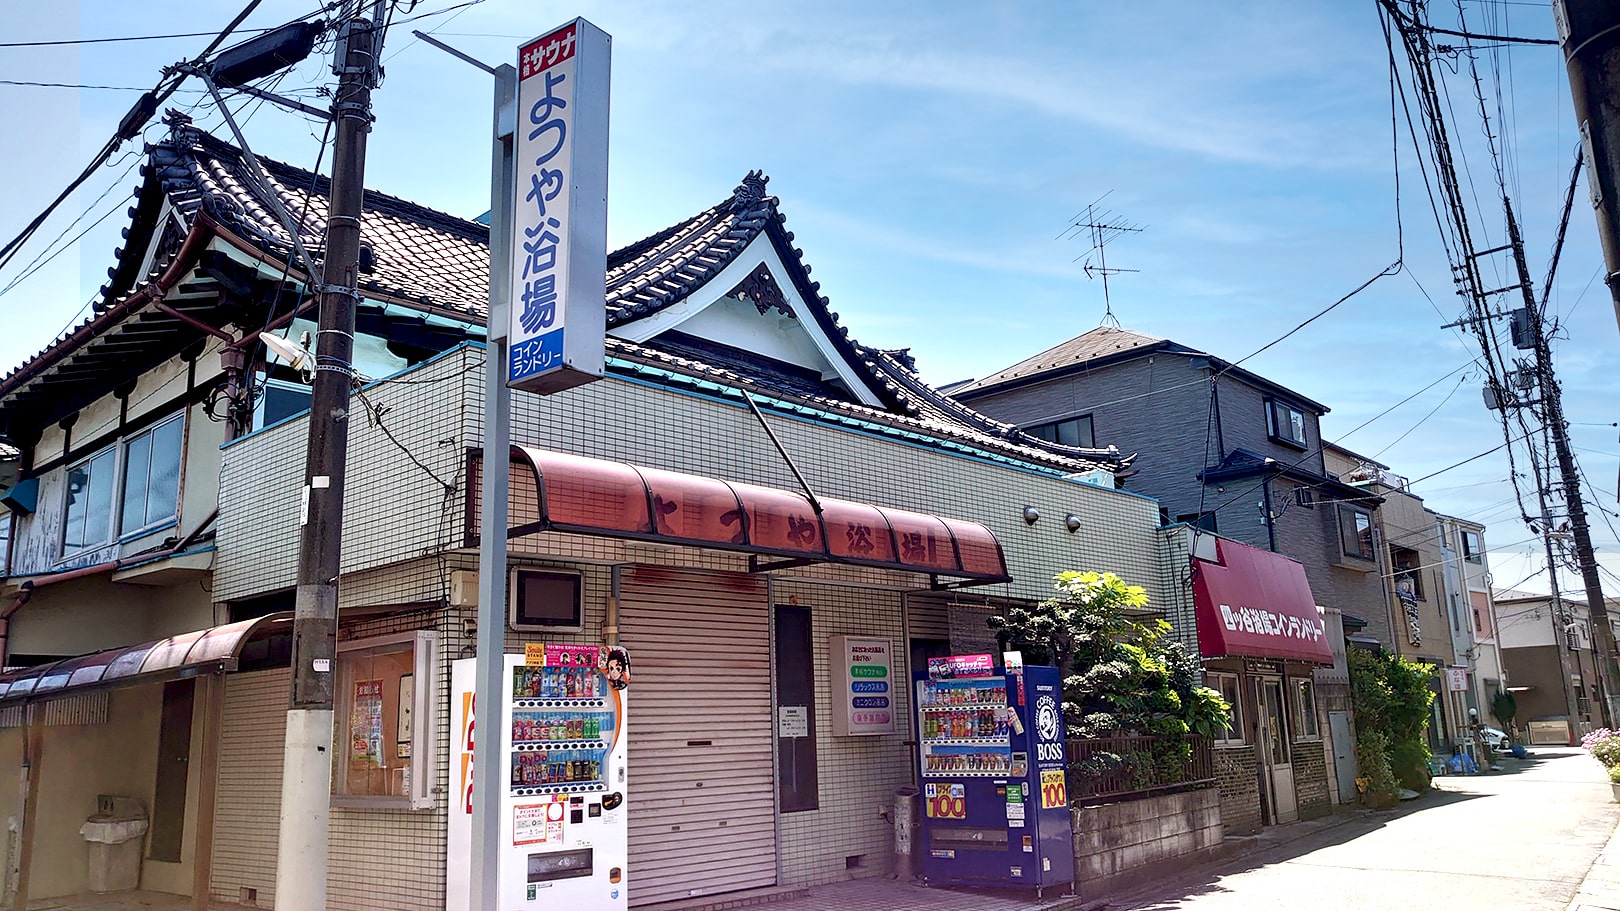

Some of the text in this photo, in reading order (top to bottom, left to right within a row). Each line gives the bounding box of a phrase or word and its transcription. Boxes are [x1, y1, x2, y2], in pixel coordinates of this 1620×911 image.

[531, 31, 576, 72] サウナ
[519, 71, 567, 334] よつや浴場
[513, 340, 543, 361] コイン
[513, 349, 561, 377] ランドリー
[1036, 695, 1056, 710] COFFEE
[519, 754, 548, 766] DyDo
[1036, 742, 1063, 761] BOSS
[930, 794, 965, 817] 100
[1043, 782, 1065, 807] 100
